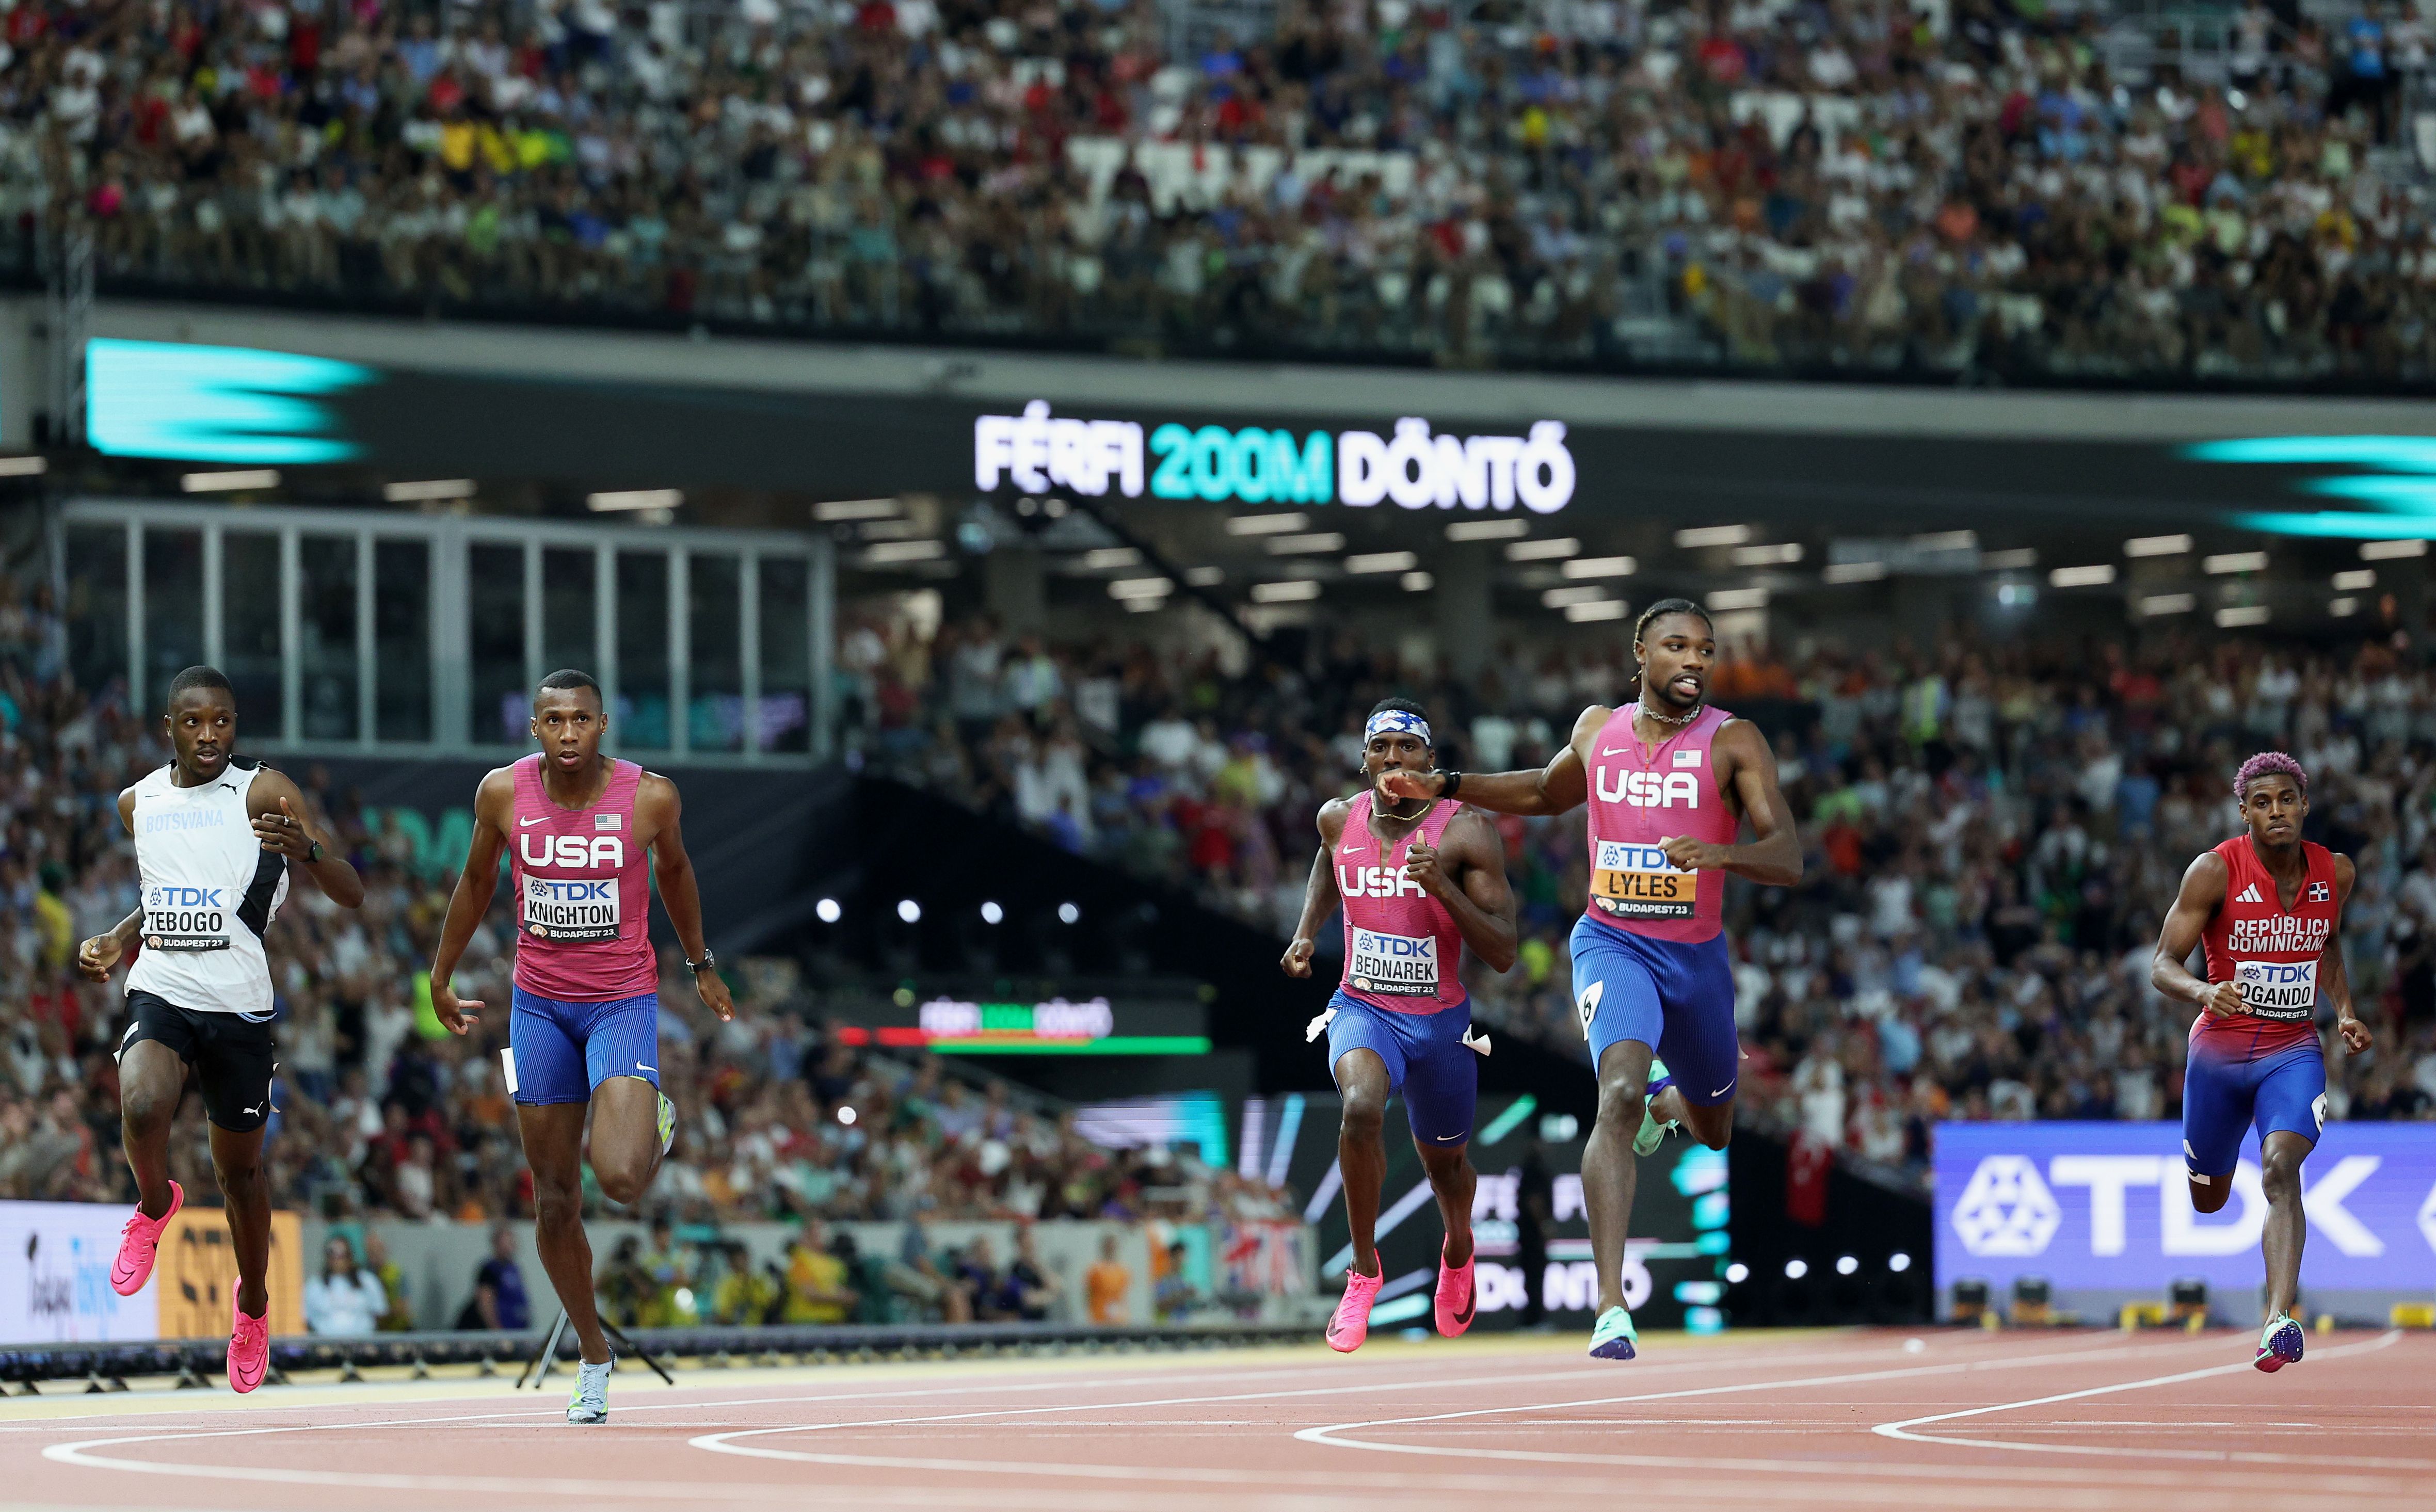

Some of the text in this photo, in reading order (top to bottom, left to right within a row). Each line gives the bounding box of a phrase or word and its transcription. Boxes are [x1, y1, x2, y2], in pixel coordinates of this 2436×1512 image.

[974, 399, 1144, 497] FÉRFI
[1150, 423, 1333, 504] 200M
[1597, 766, 1698, 808] USA
[147, 810, 223, 833] BOTSWANA
[520, 834, 623, 868] USA
[546, 882, 611, 900] TDK
[1339, 865, 1426, 897] USA
[1609, 873, 1677, 897] LYLES
[163, 888, 222, 907] TDK
[1619, 904, 1687, 914] BUDAPEST 23
[149, 912, 222, 931] TEBOGO
[530, 900, 613, 924] KNIGHTON
[2235, 914, 2329, 937] REPÚBLICA
[1374, 936, 1431, 957] TDK
[1356, 955, 1434, 980] BEDNAREK
[2262, 964, 2312, 982] TDK
[1374, 983, 1421, 992] BUDAPEST
[2240, 983, 2310, 1005] OGANDO
[2256, 1008, 2300, 1018] BUDAPEST
[2050, 1154, 2385, 1257] TDK
